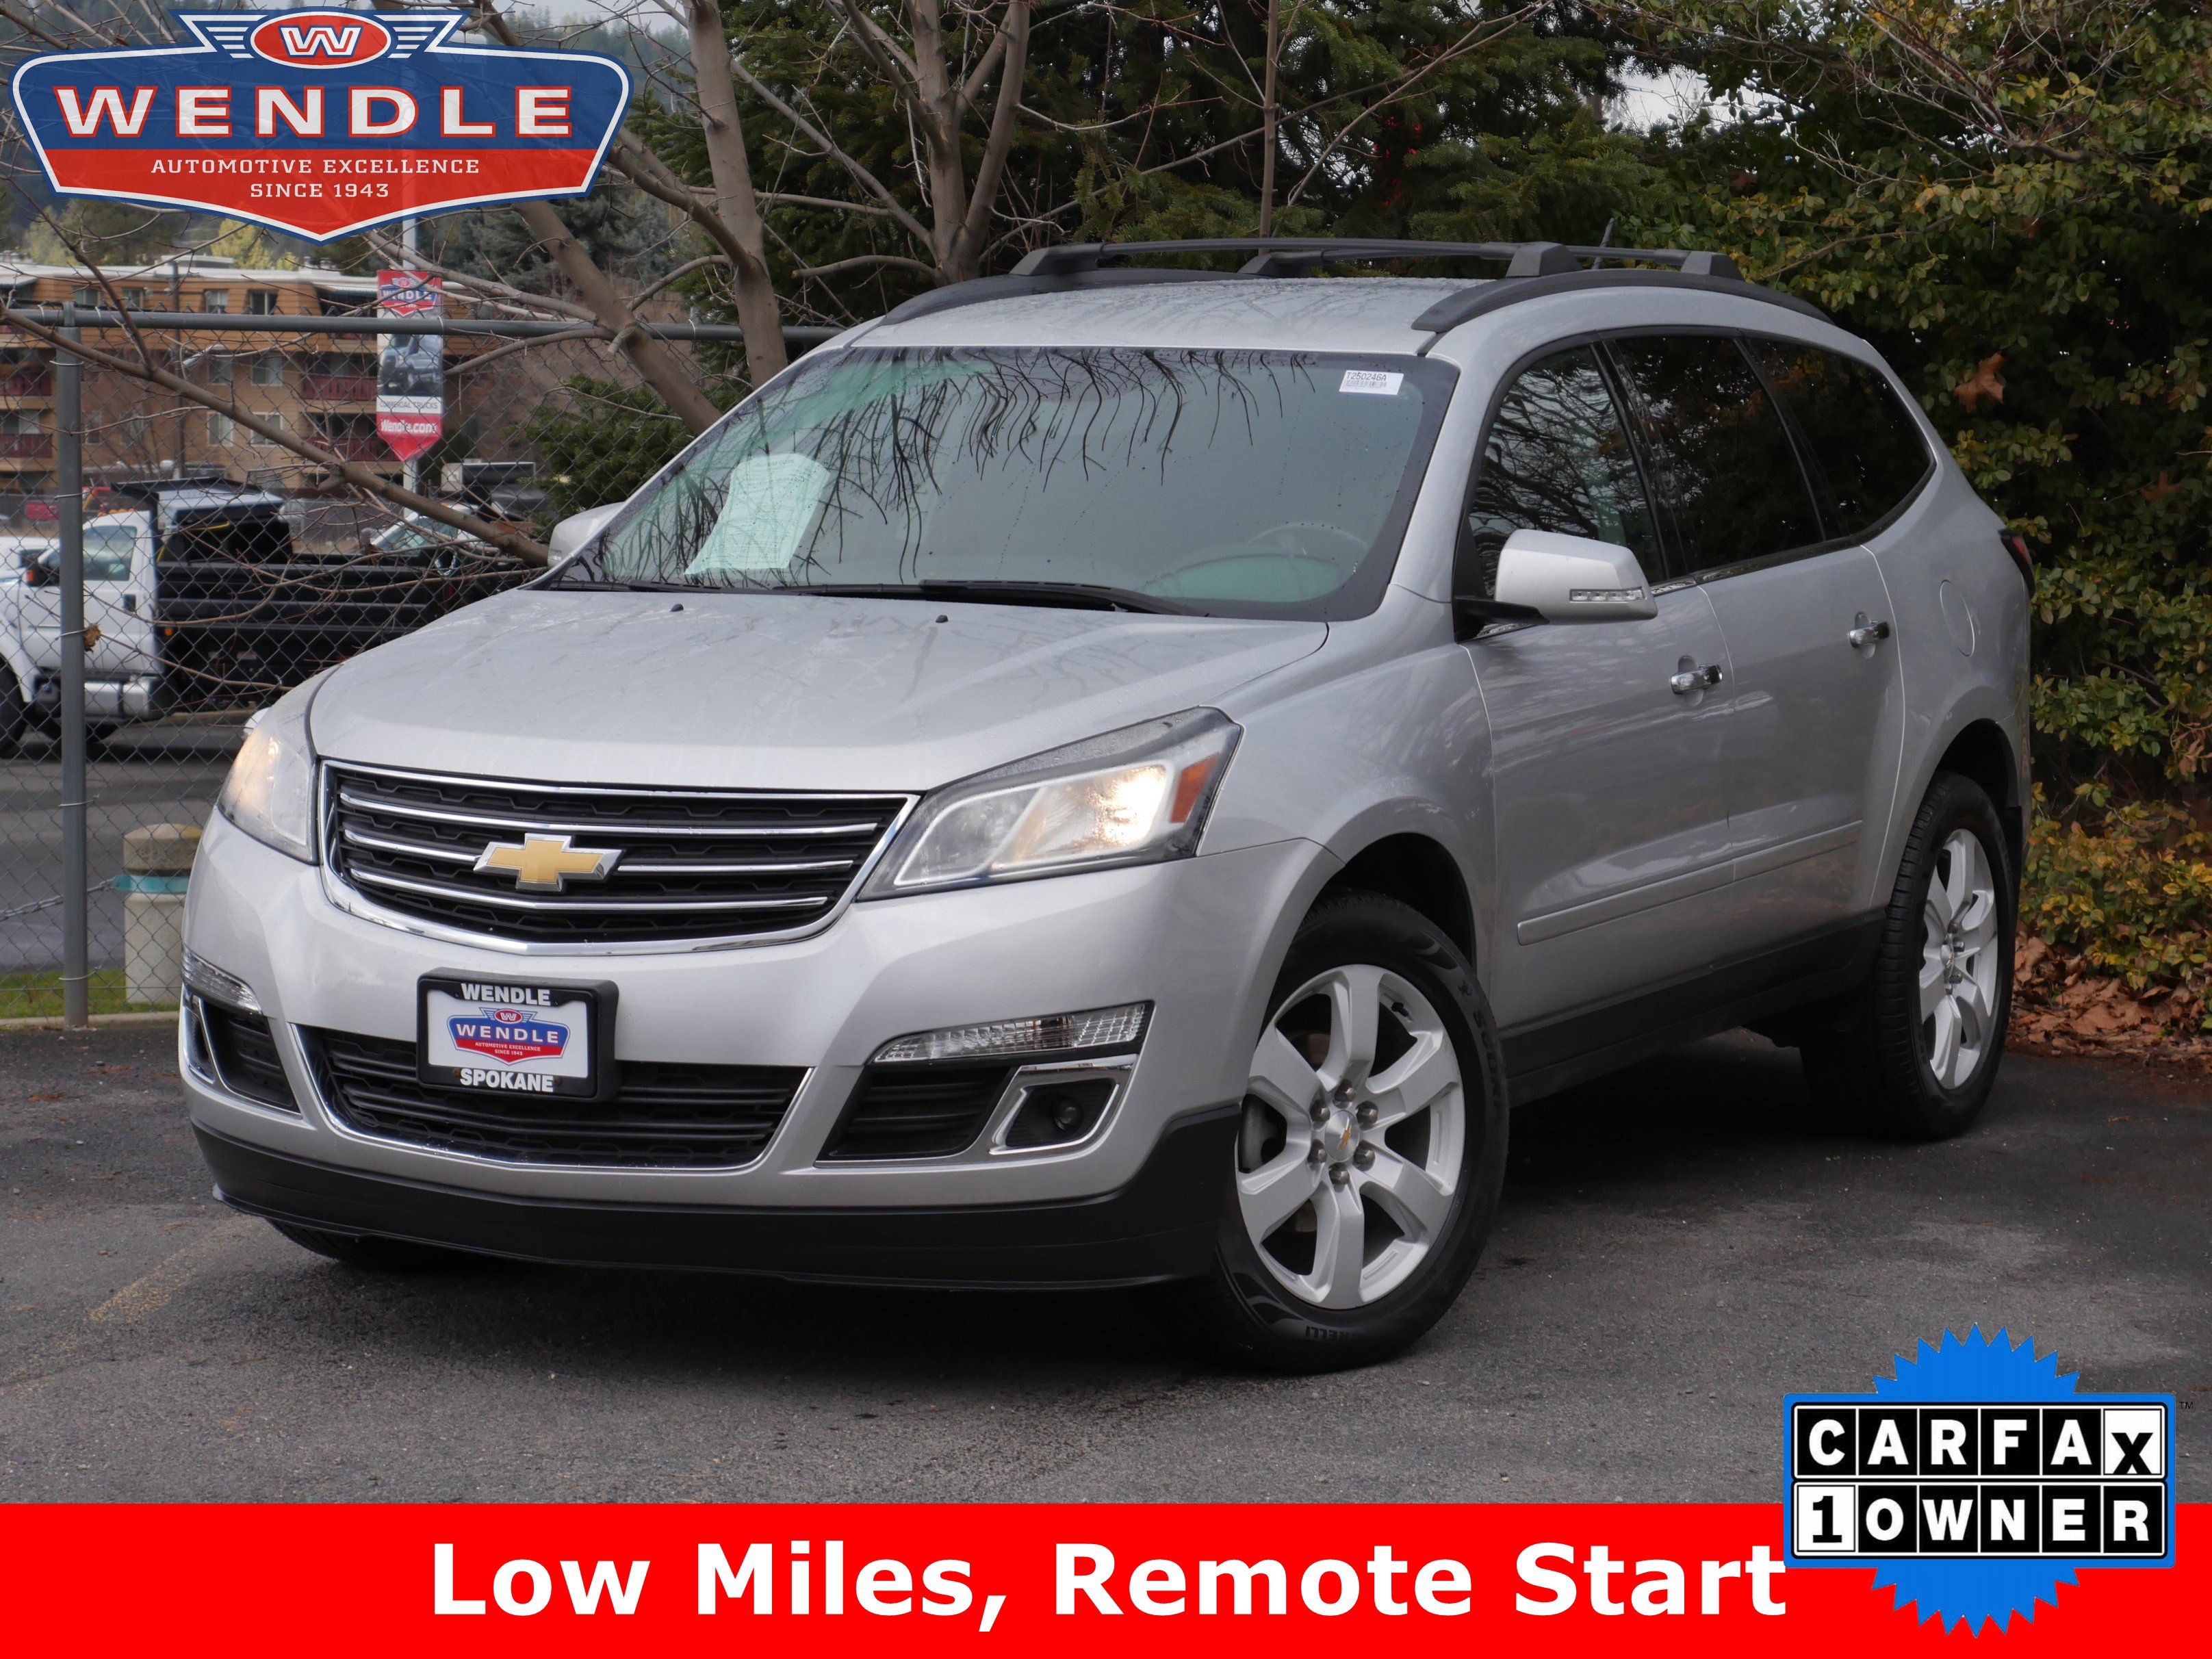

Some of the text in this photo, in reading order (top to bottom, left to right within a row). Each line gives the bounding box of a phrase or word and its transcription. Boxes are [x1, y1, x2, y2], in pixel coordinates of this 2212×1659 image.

[1346, 372, 1387, 382] T250246A
[461, 982, 551, 1007] WENDLE
[456, 1023, 558, 1044] WENDLE
[460, 1068, 554, 1092] SPOKANE
